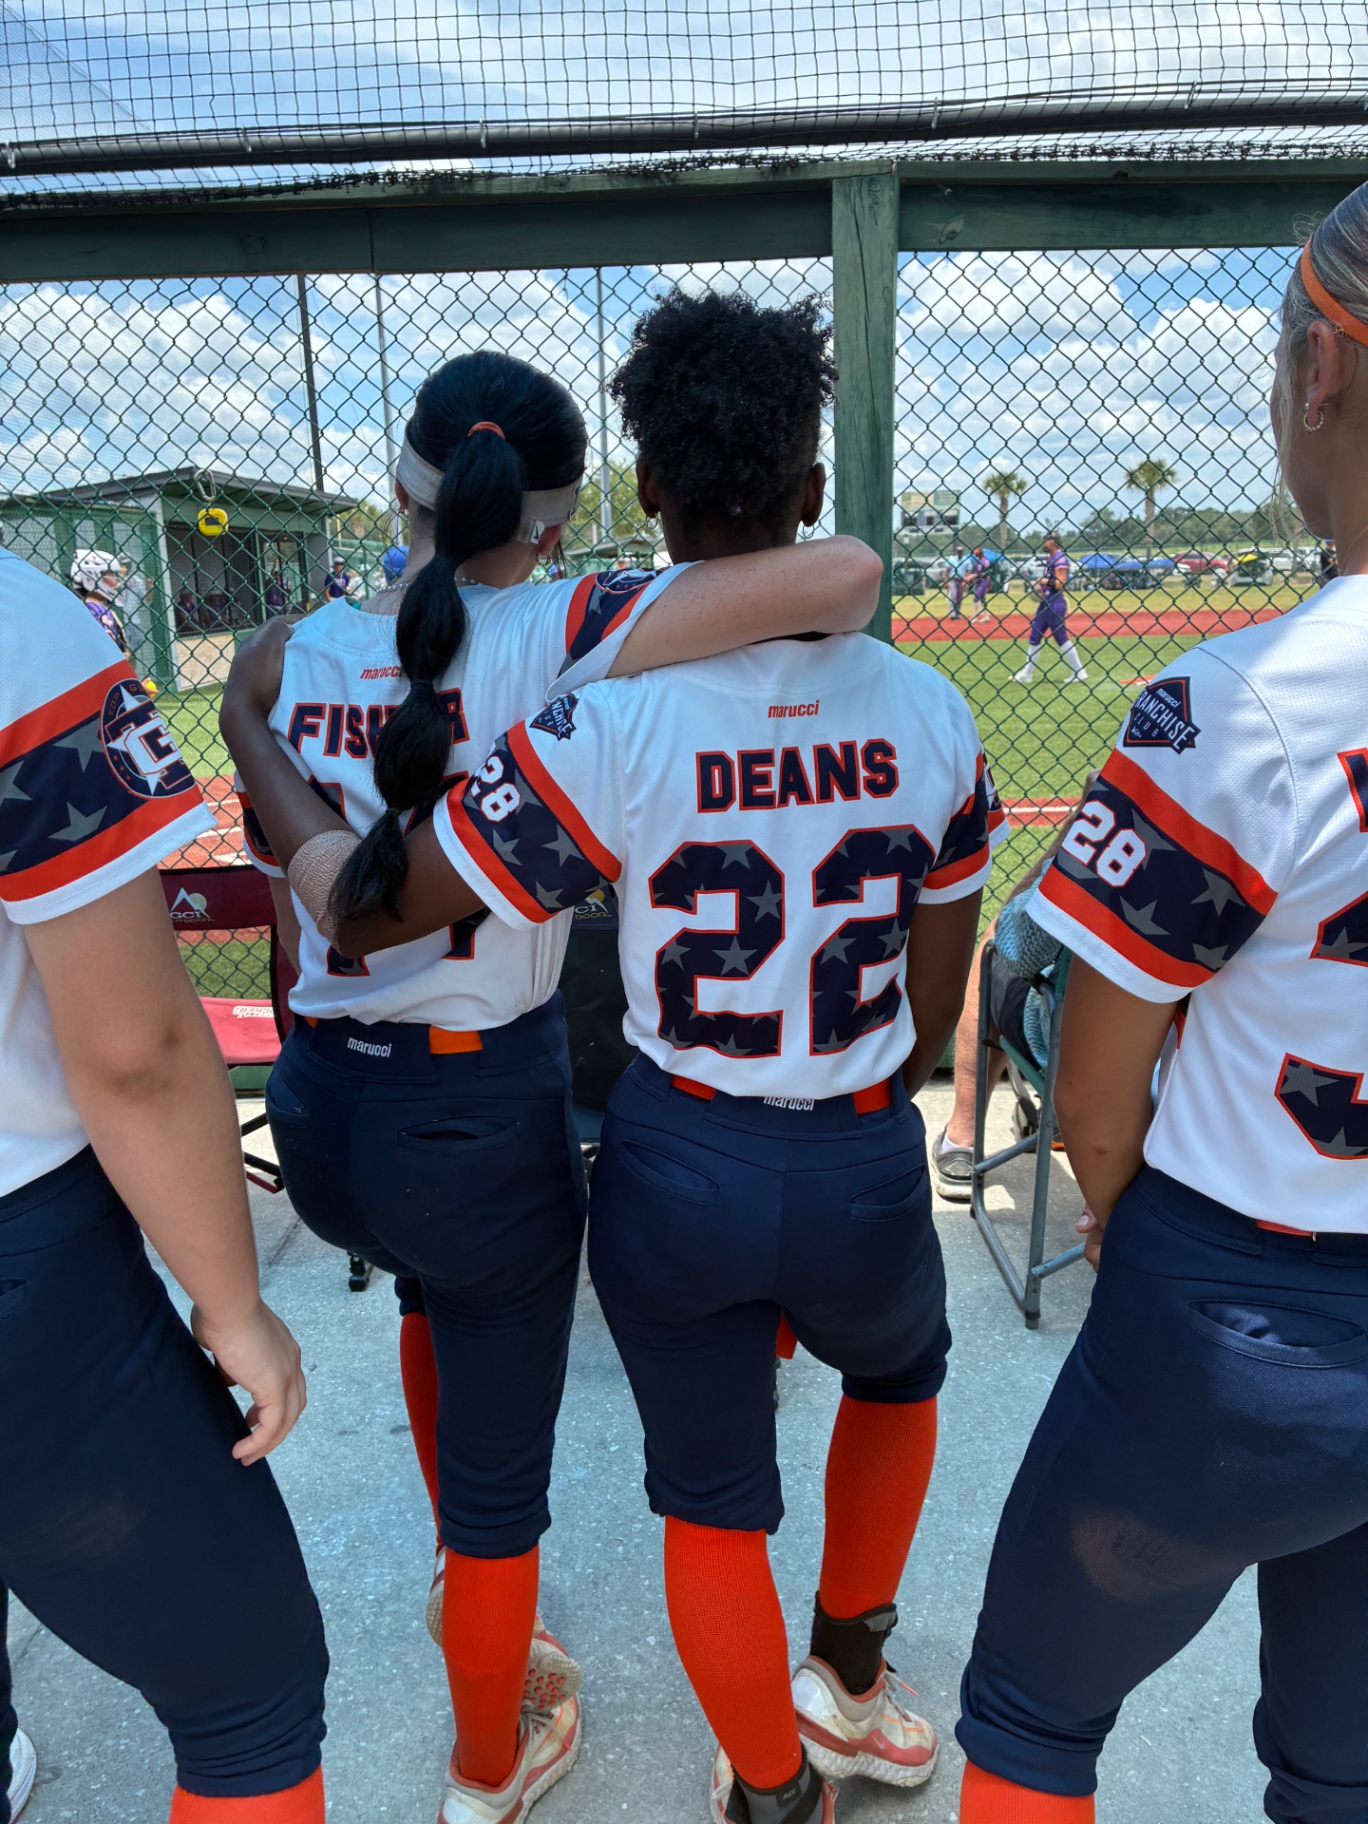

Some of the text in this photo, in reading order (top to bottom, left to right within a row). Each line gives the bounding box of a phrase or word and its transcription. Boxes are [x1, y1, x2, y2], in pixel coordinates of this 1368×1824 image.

[287, 688, 470, 759] FISHR
[767, 699, 820, 718] marucci
[1135, 690, 1195, 750] RANCHISE
[1156, 688, 1182, 708] marucci
[470, 741, 521, 822] 28
[695, 738, 900, 813] DEANS
[1061, 799, 1147, 888] 28
[648, 824, 937, 1058] 22
[347, 1037, 393, 1058] marucci
